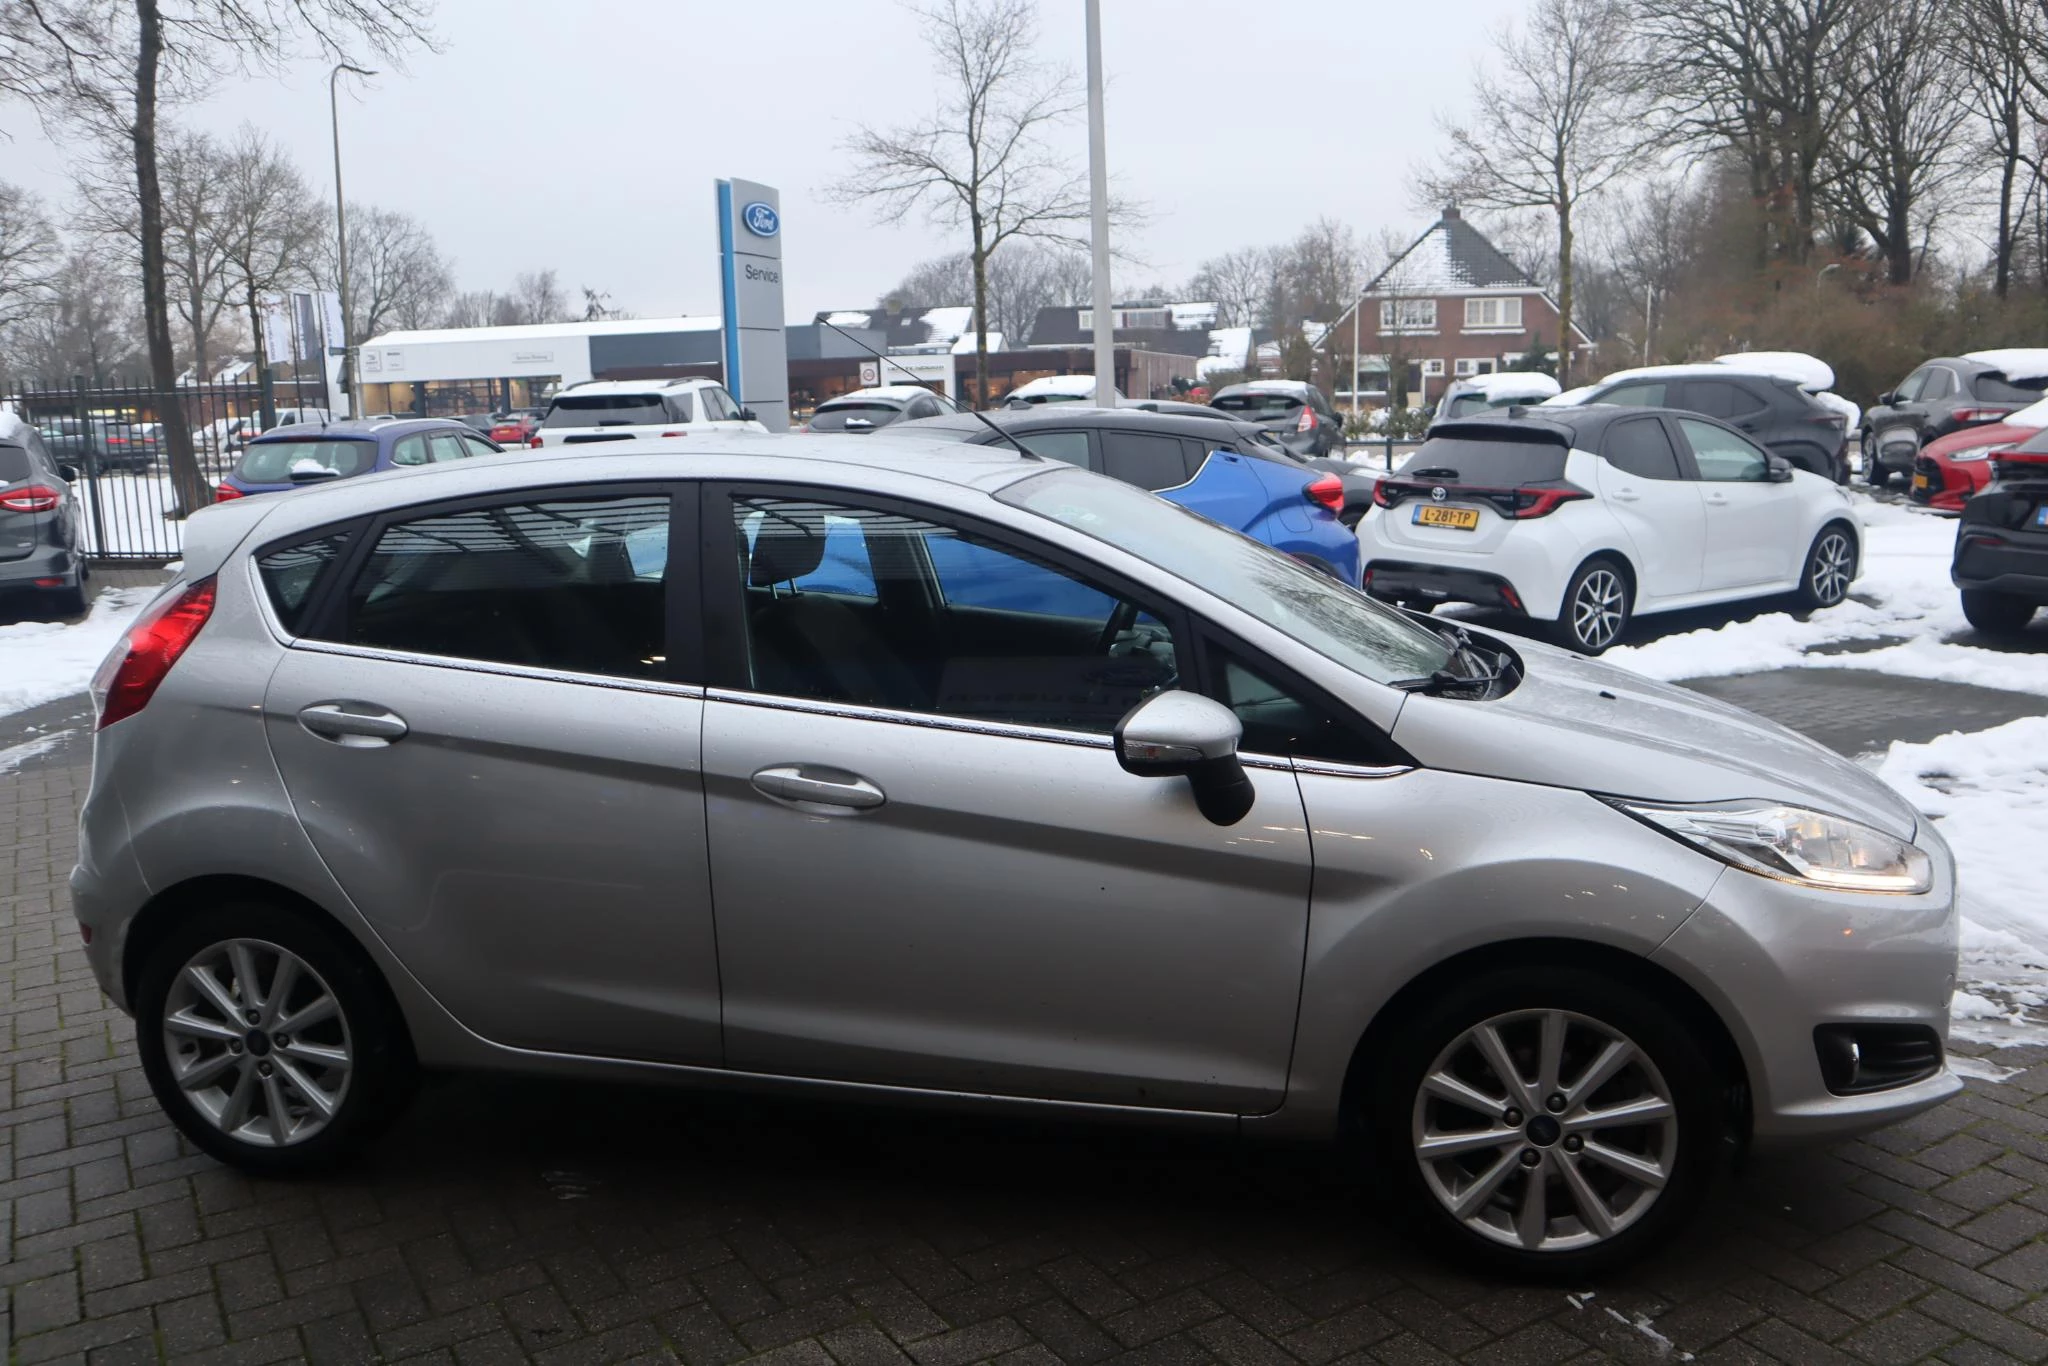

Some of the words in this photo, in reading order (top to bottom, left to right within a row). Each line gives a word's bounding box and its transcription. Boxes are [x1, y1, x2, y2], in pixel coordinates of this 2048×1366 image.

[754, 207, 774, 230] Ford
[745, 264, 778, 283] Service
[1424, 509, 1471, 524] L-281-TP
